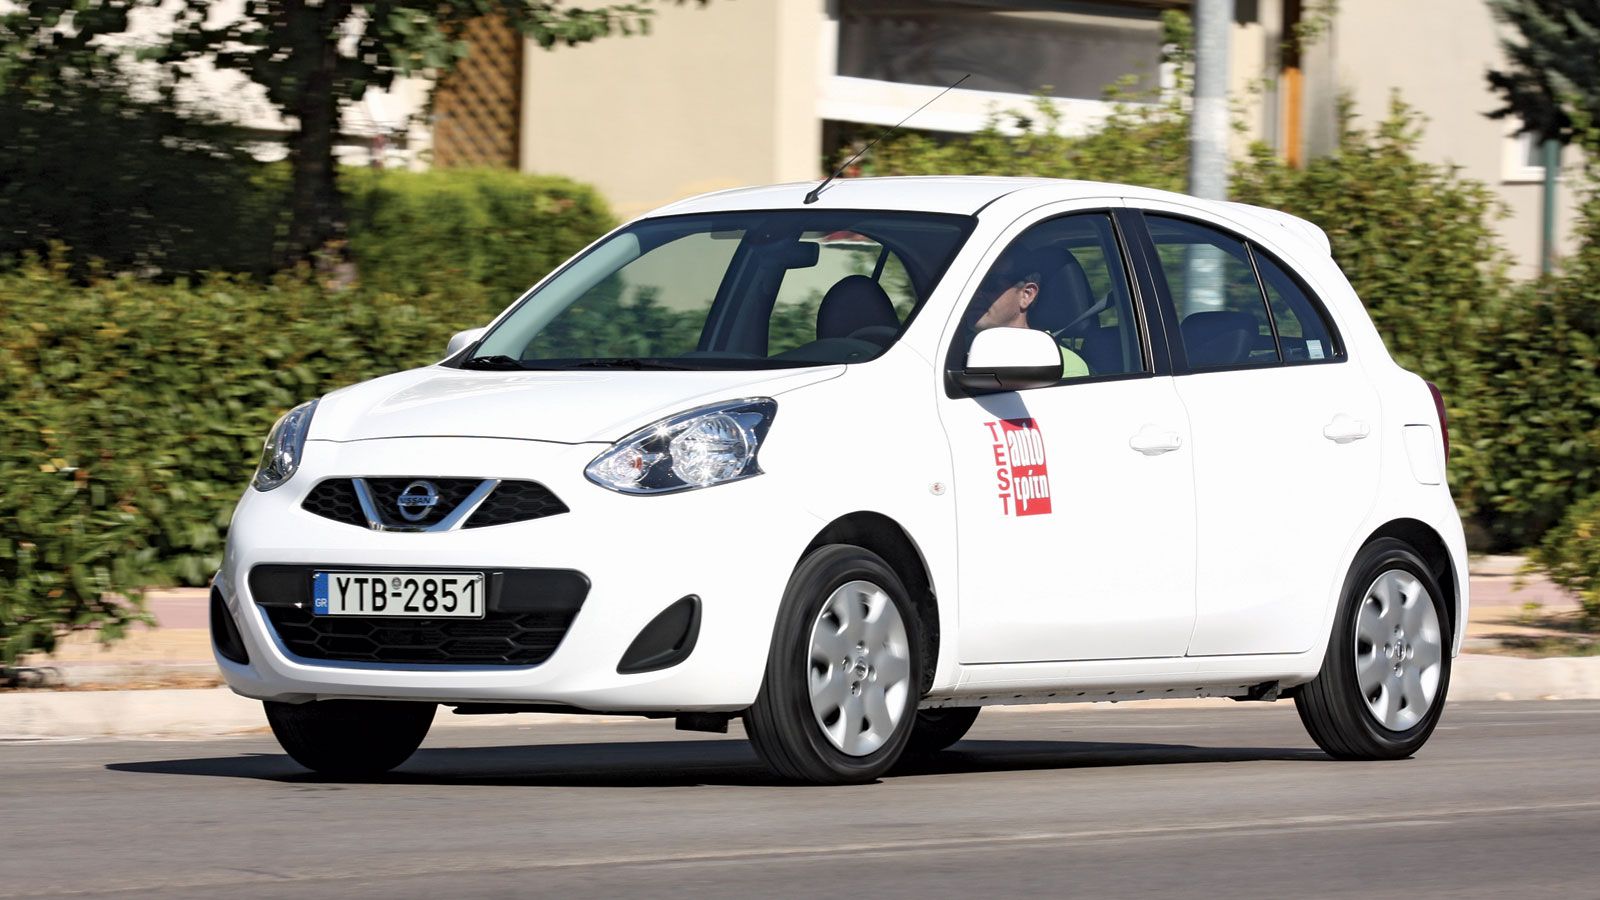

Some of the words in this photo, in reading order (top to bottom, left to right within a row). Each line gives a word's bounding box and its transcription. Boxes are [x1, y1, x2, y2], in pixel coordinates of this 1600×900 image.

[1006, 421, 1046, 468] auto
[983, 421, 1012, 516] TEST
[314, 598, 328, 608] GR
